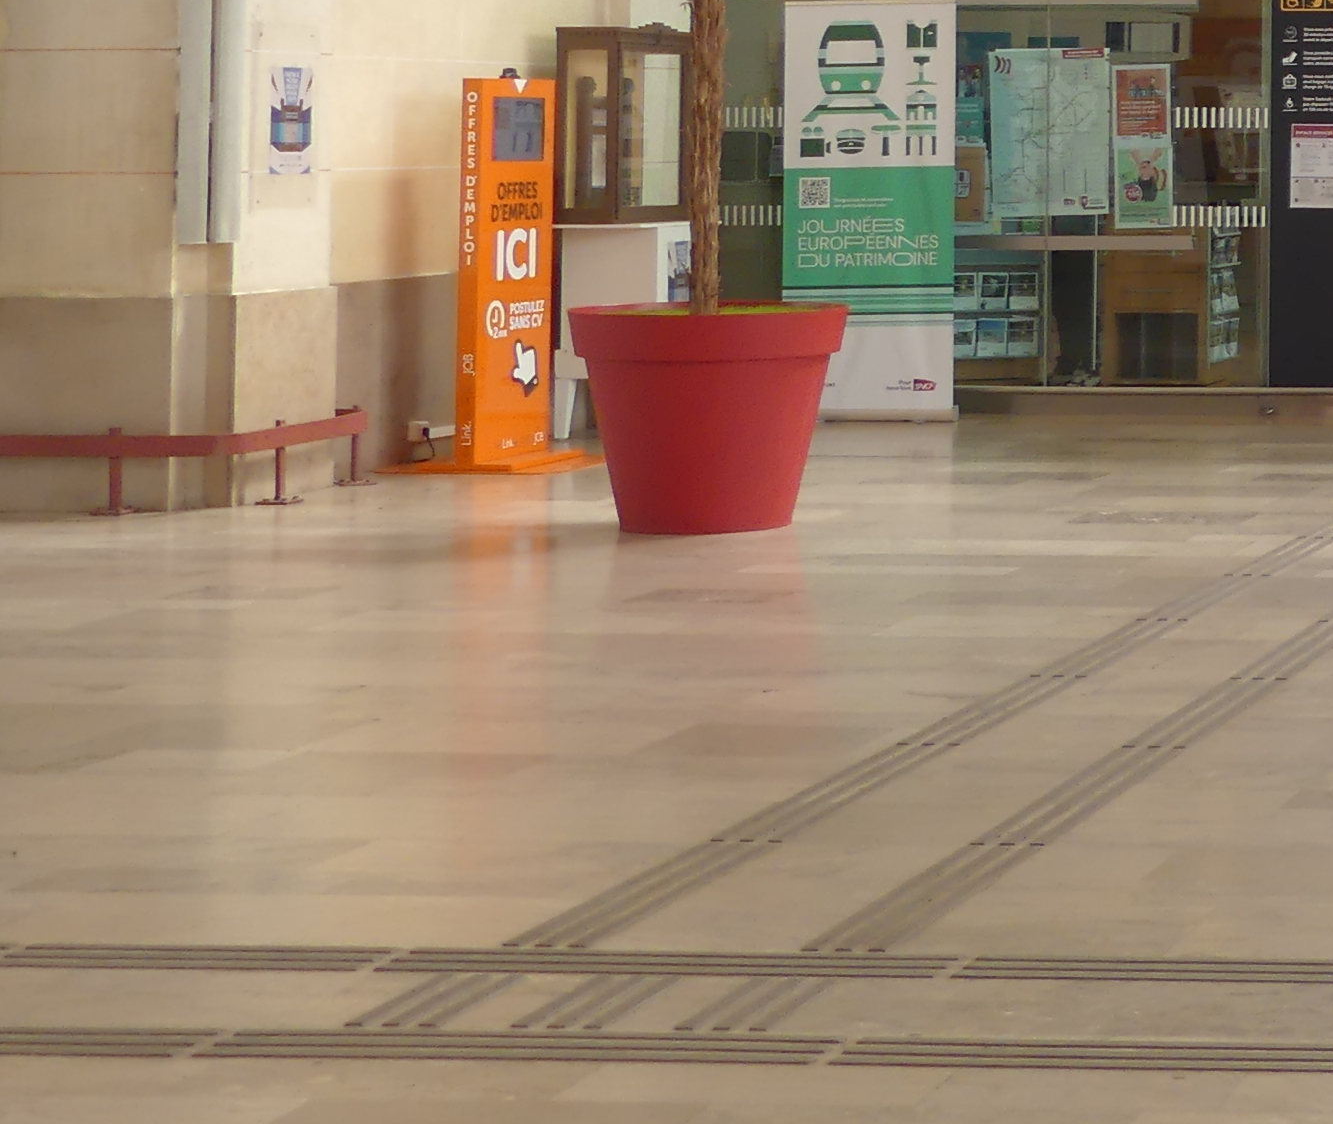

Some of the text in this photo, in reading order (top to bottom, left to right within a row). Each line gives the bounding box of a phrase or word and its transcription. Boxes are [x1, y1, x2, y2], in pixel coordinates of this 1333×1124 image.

[466, 91, 478, 169] OFFRES
[497, 181, 538, 200] OFFRES
[491, 202, 543, 223] D'EMPLOI
[797, 216, 905, 234] JOURNÉES
[798, 234, 939, 251] EUROPÉENNES
[496, 228, 537, 282] ICI
[798, 252, 938, 268] DU PATRIMOINE
[509, 300, 545, 316] POSTULEZ
[509, 313, 543, 330] SANS CV
